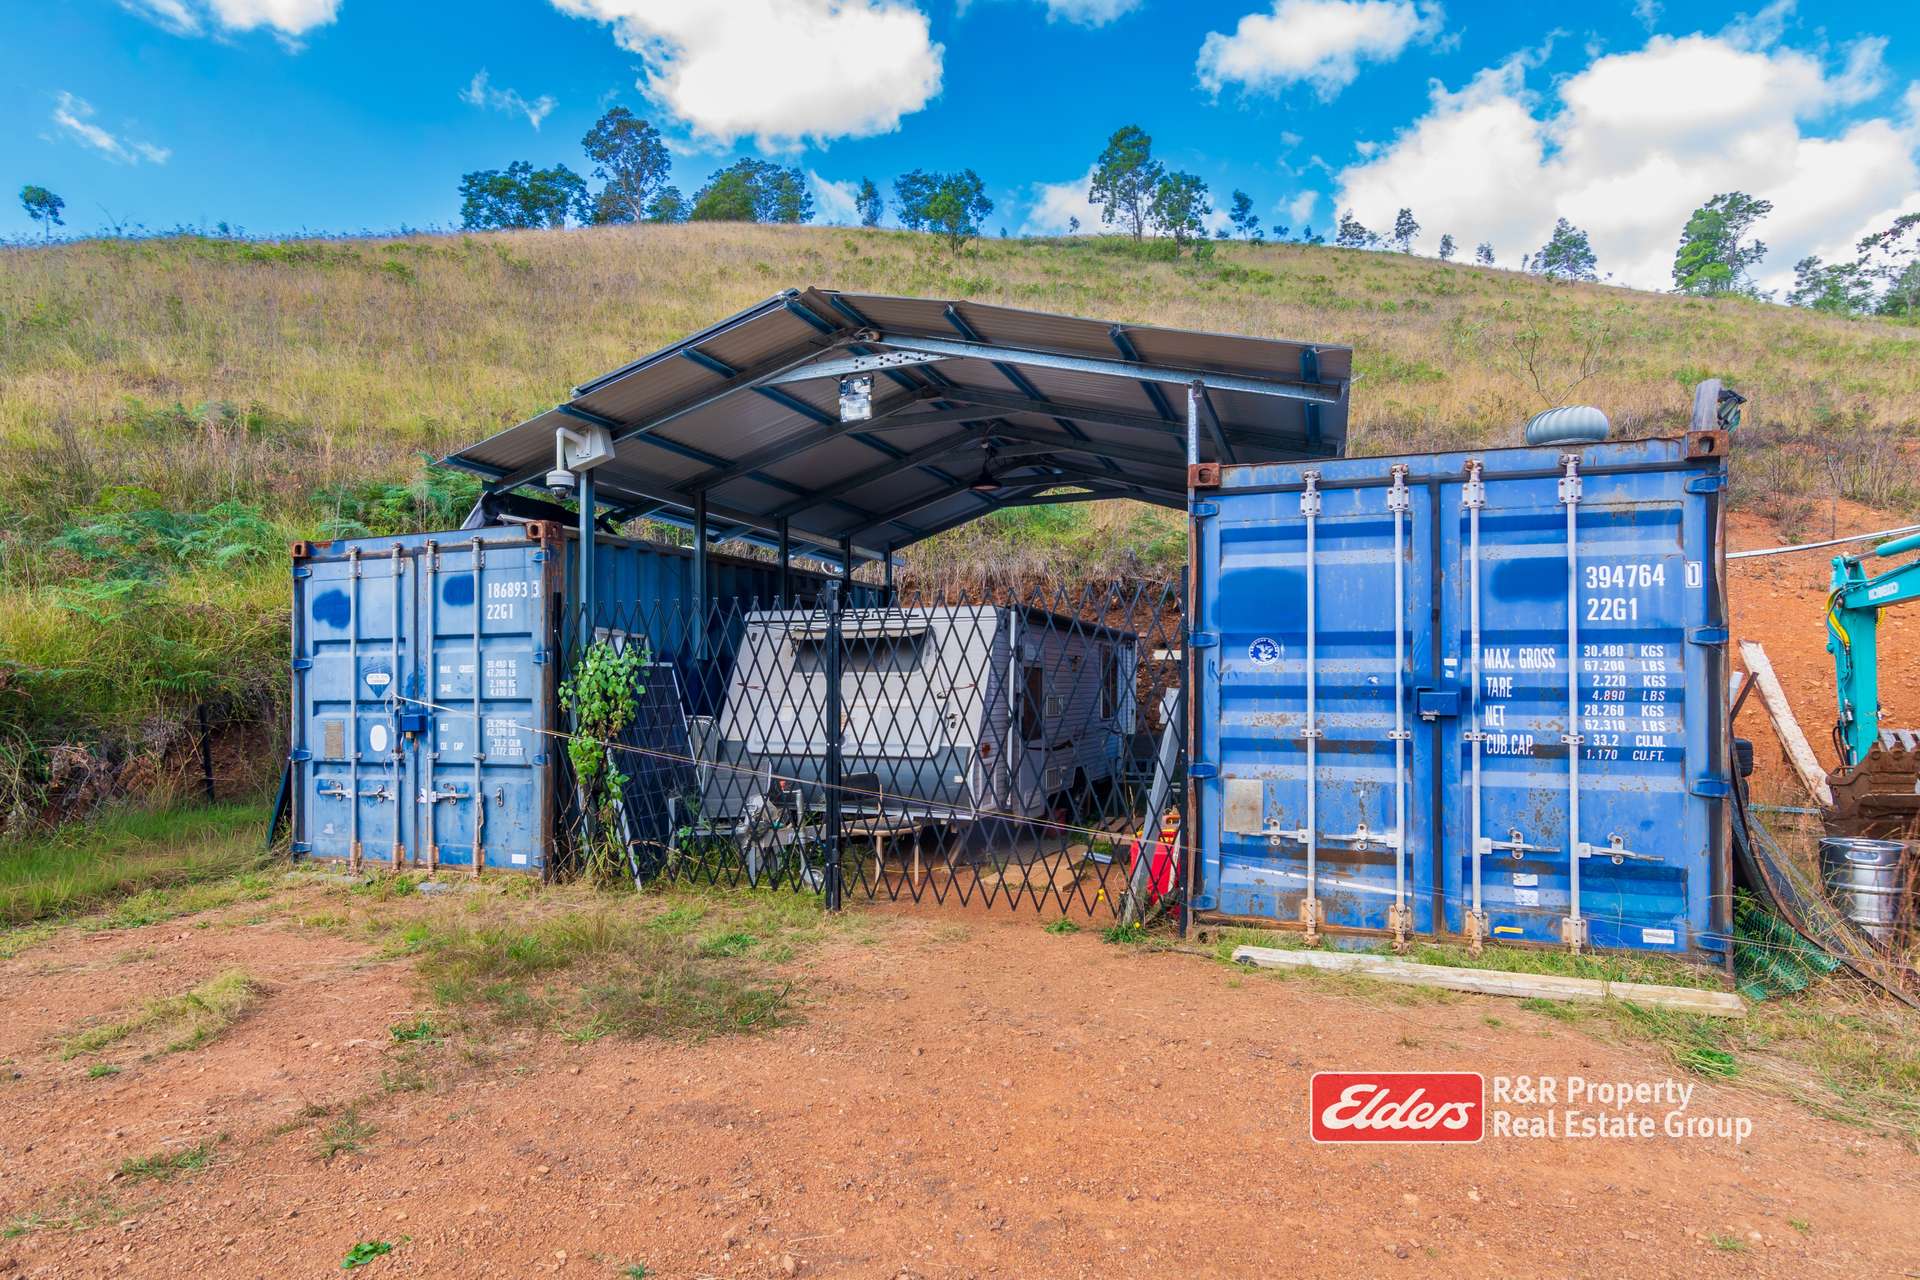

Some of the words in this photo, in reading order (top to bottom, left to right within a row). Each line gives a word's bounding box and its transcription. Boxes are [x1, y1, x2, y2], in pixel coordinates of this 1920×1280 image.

[1586, 563, 1665, 588] 394764
[487, 581, 528, 598] 186893
[487, 603, 513, 620] 22G1
[1587, 597, 1638, 620] 22G1
[1484, 647, 1515, 669] MAX.
[1519, 647, 1556, 669] GROSS
[1640, 645, 1664, 657] KGS
[1641, 660, 1666, 672] LBS
[1485, 676, 1513, 698] TARE
[1643, 675, 1667, 687] KGS
[1642, 690, 1666, 702] LBS
[1484, 704, 1506, 727] NET
[1641, 704, 1665, 717] KGS
[1642, 720, 1666, 732] LBS
[1593, 734, 1620, 747] 33.2
